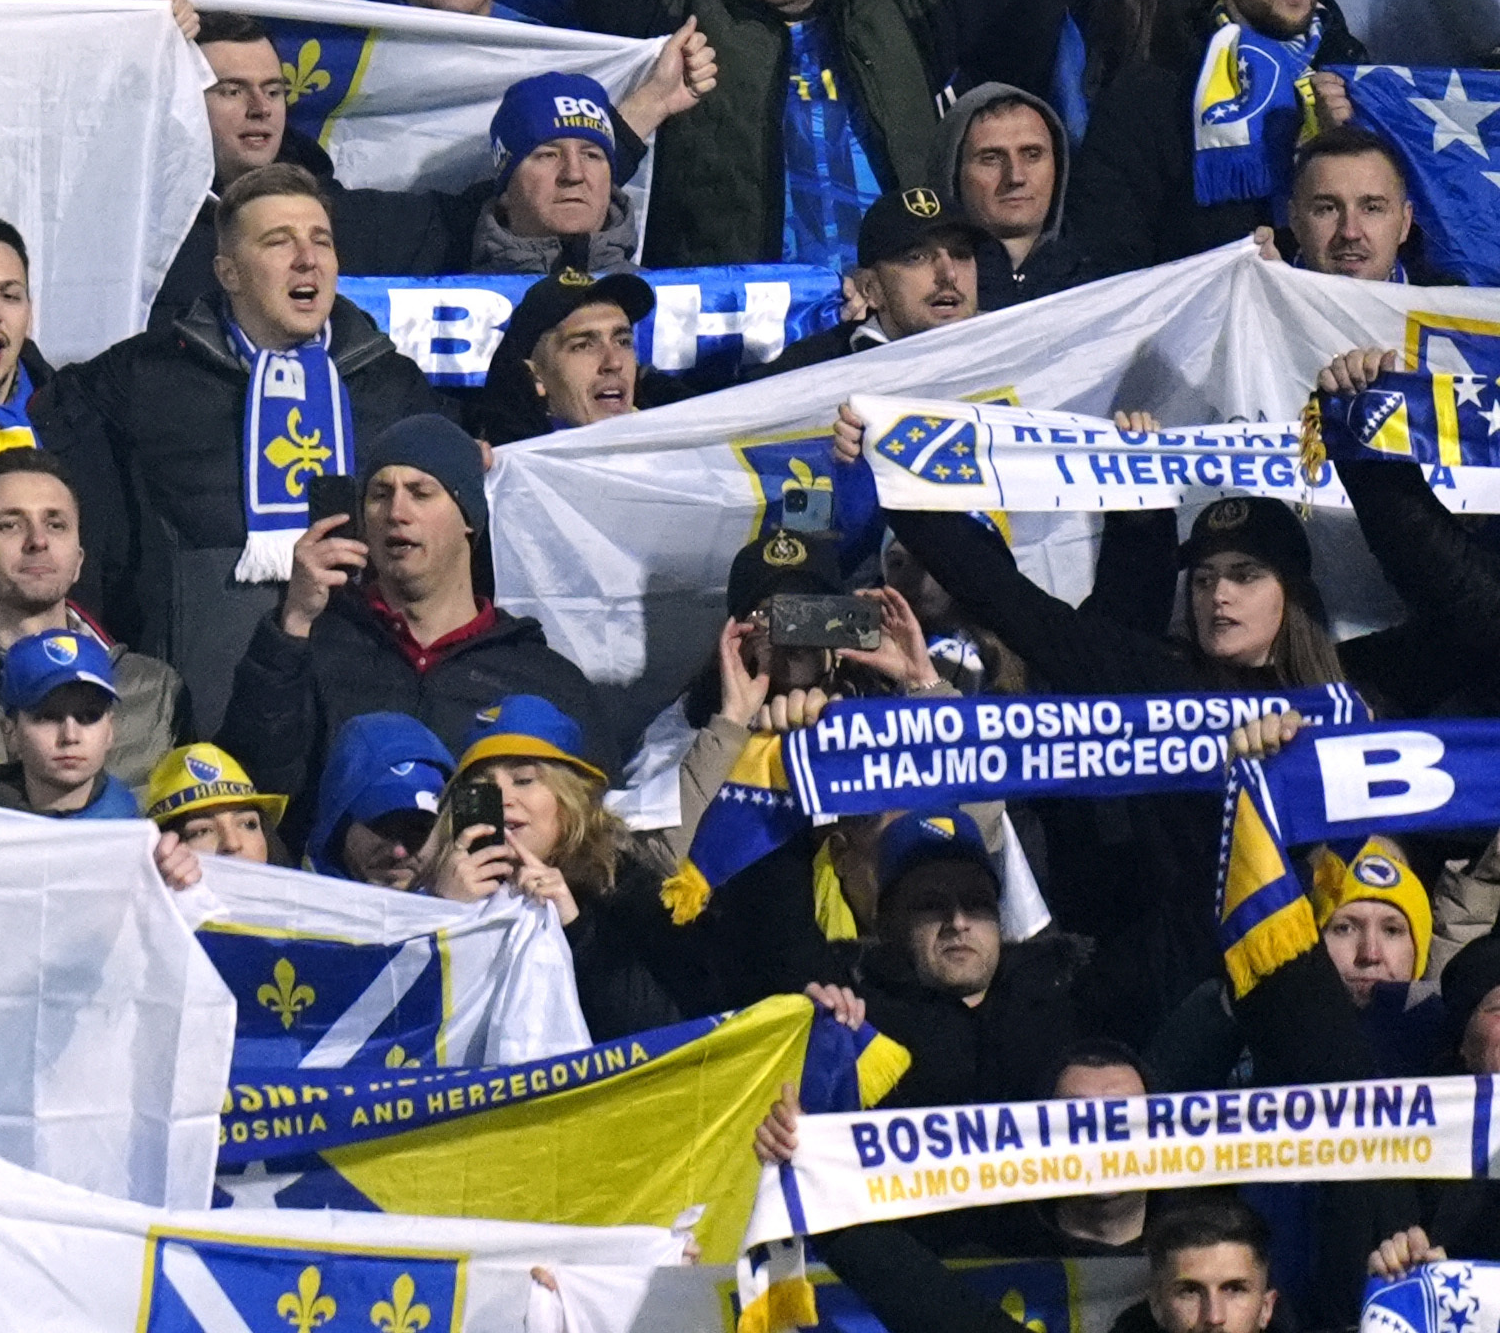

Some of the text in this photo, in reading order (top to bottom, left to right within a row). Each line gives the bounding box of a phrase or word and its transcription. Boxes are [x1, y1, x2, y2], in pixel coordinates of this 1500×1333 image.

[818, 699, 1135, 753] HAJMO BOSNO,
[830, 744, 1008, 794] ...HAJMO
[351, 1097, 415, 1127] AND
[426, 1041, 652, 1115] HERZEGOVINA
[850, 1106, 1054, 1169] BOSNA I
[866, 1135, 1434, 1205] HAJMO BOSNO, HAJMO HERCEGOVINO
